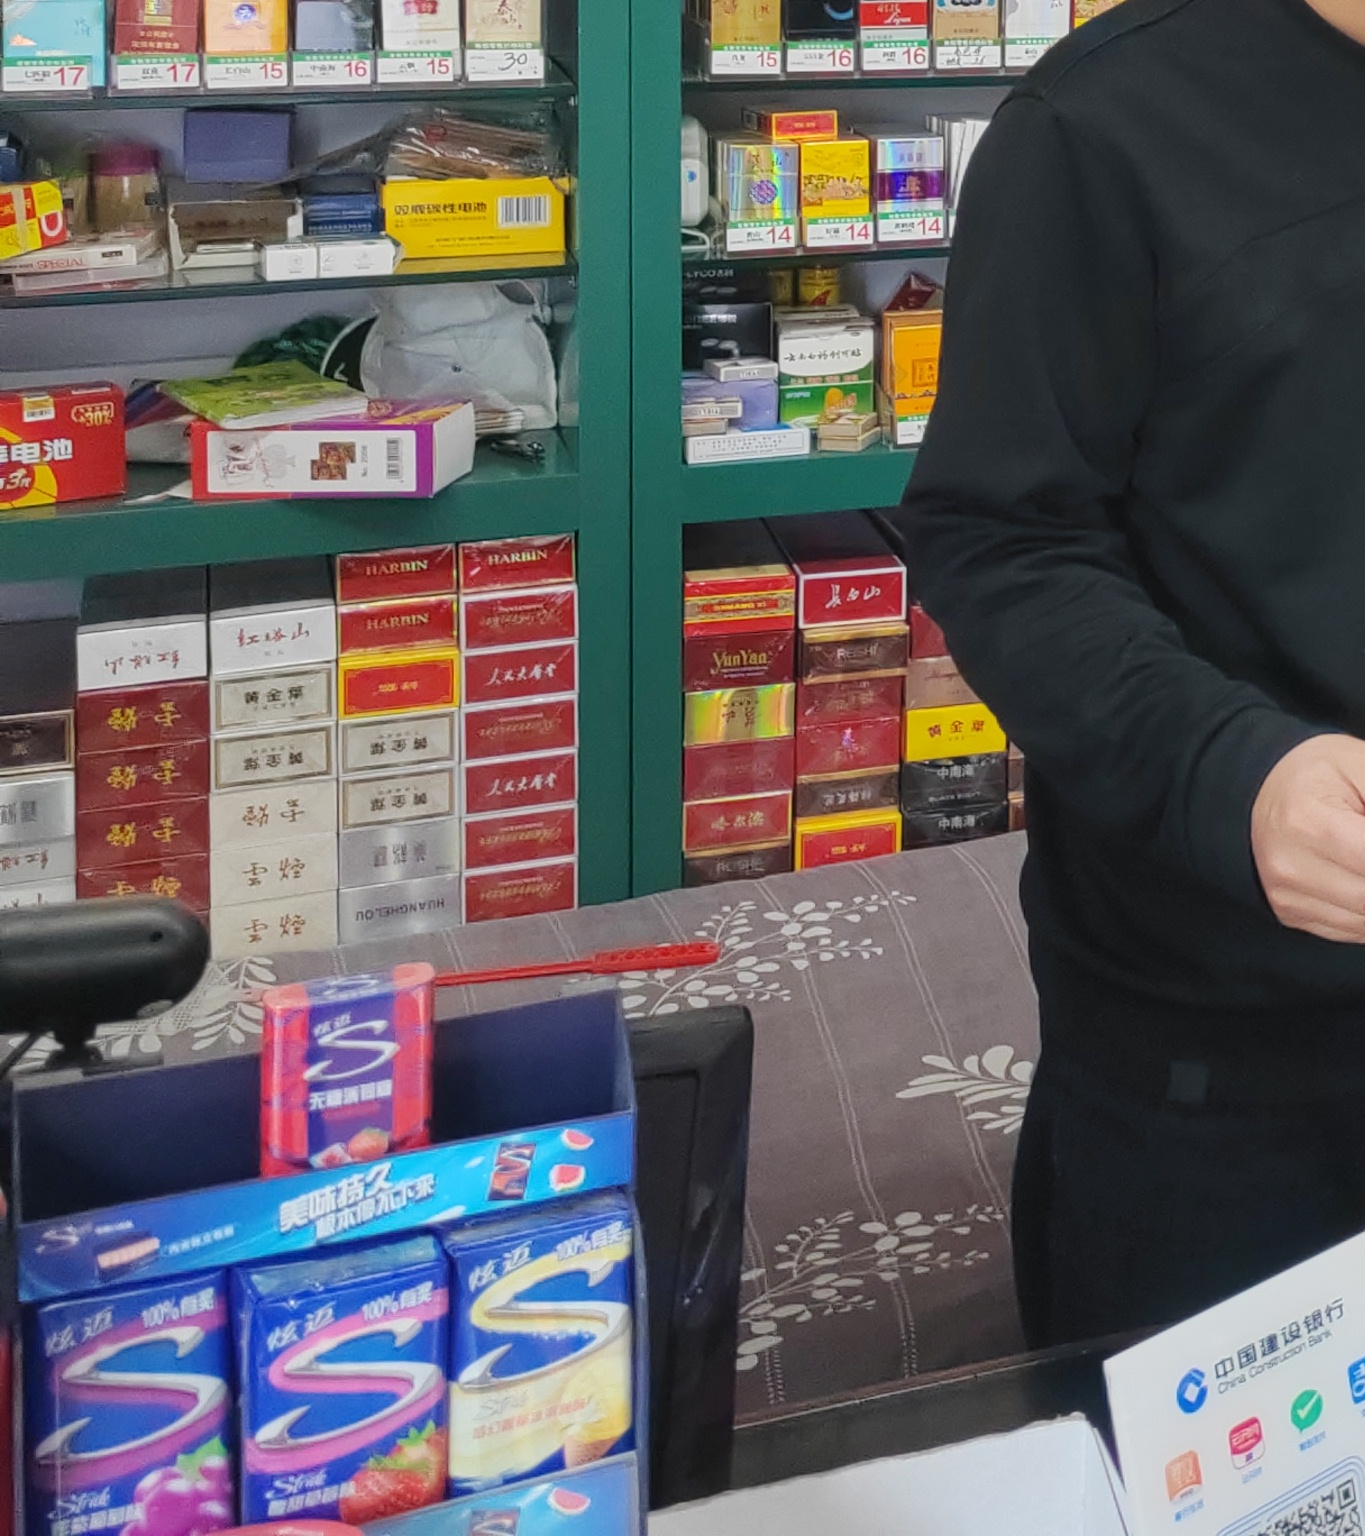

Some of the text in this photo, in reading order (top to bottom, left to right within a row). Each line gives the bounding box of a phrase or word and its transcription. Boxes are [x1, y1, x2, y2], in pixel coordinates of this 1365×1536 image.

[756, 51, 777, 68] 15
[827, 49, 851, 66] 16
[902, 47, 926, 64] 16
[166, 64, 197, 83] 17
[259, 62, 284, 80] 15
[344, 60, 367, 77] 16
[426, 58, 450, 75] 15
[53, 66, 85, 86] 17
[766, 225, 792, 243] 14
[845, 223, 870, 241] 14
[917, 218, 941, 236] 14
[487, 548, 549, 568] HARBIN
[365, 558, 429, 578] HARBIN
[365, 612, 430, 631] HARBIN
[937, 765, 975, 779] 中南海
[938, 816, 976, 830] 中南海
[354, 898, 446, 921] HUANGHELOU
[279, 1161, 393, 1232] 美味持久
[1214, 1297, 1345, 1380] 中国建设银行
[1217, 1328, 1333, 1395] China Construction Bank
